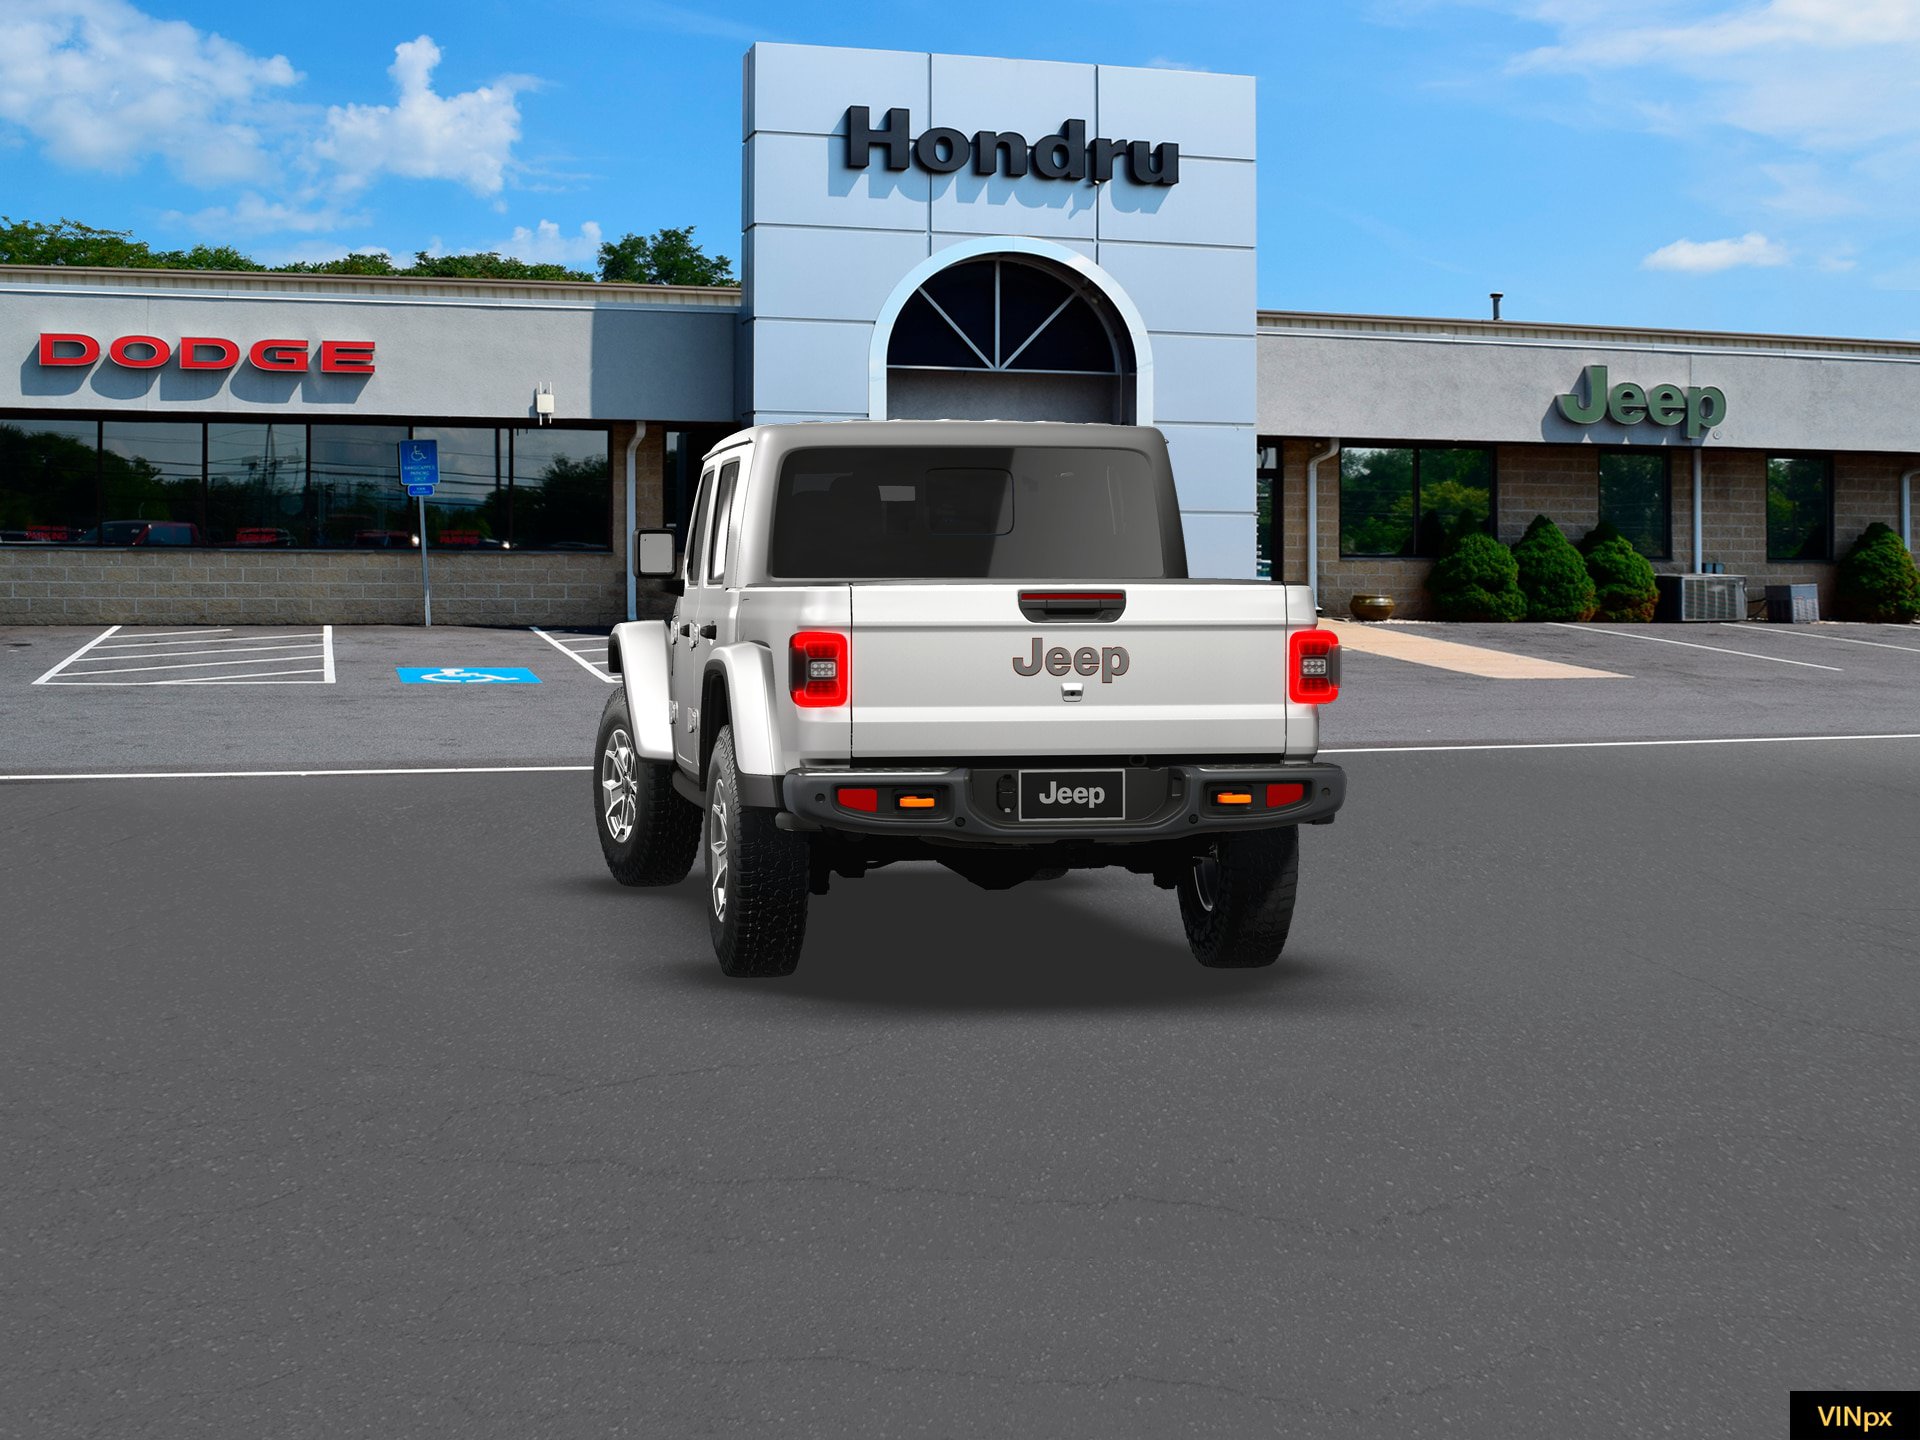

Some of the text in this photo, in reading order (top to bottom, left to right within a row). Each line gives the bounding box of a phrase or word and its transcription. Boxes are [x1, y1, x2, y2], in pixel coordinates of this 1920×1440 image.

[846, 105, 1179, 185] Hondru
[39, 332, 376, 374] DODGE
[1558, 365, 1726, 439] Jeep
[1013, 637, 1130, 684] Jeep
[1039, 781, 1105, 809] Jeep
